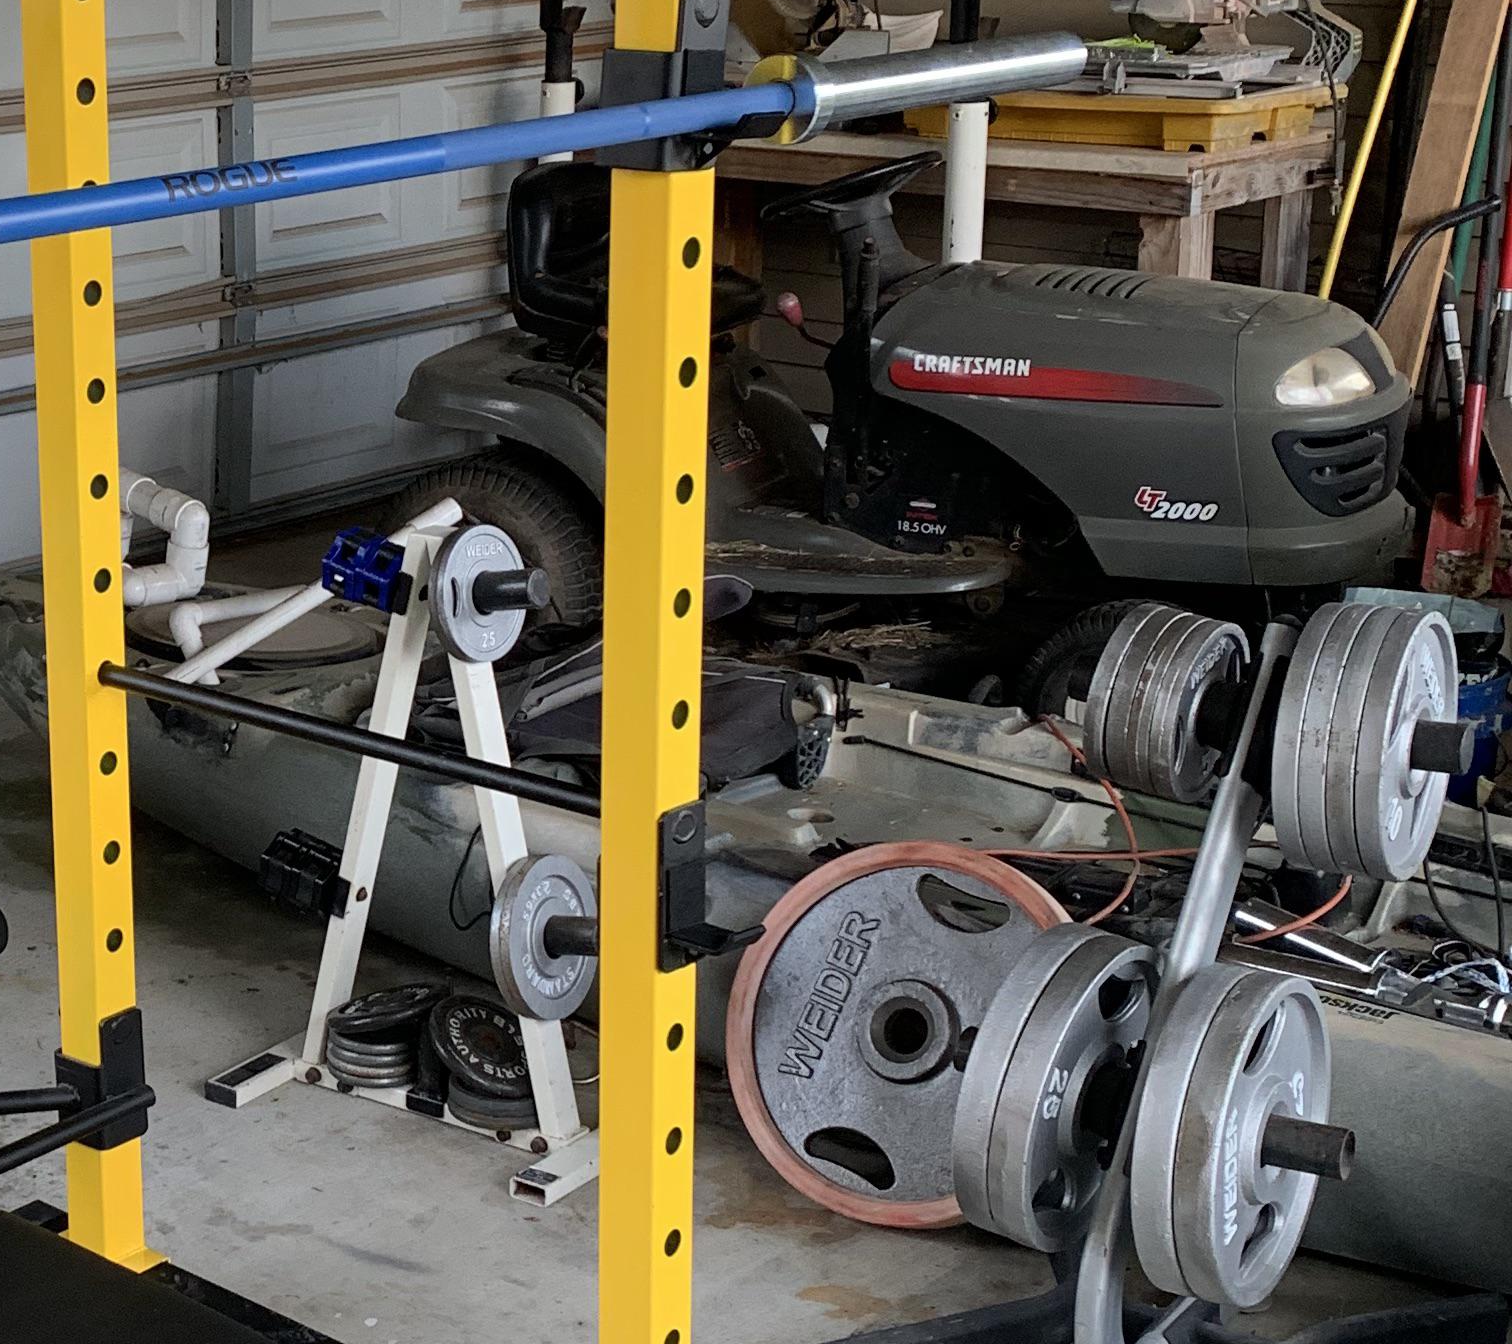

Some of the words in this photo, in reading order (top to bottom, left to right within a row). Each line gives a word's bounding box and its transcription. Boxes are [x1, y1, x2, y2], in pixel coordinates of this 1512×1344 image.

[161, 158, 298, 202] ROGUE
[913, 353, 1032, 377] CRAFTSMAN
[1134, 485, 1168, 512] LT
[1149, 500, 1220, 521] 2000
[897, 519, 920, 533] 18.5
[920, 522, 947, 535] OHV
[465, 542, 504, 557] WEIDER
[778, 910, 882, 1079] WEIDER
[1223, 1107, 1239, 1246] WEIDER
